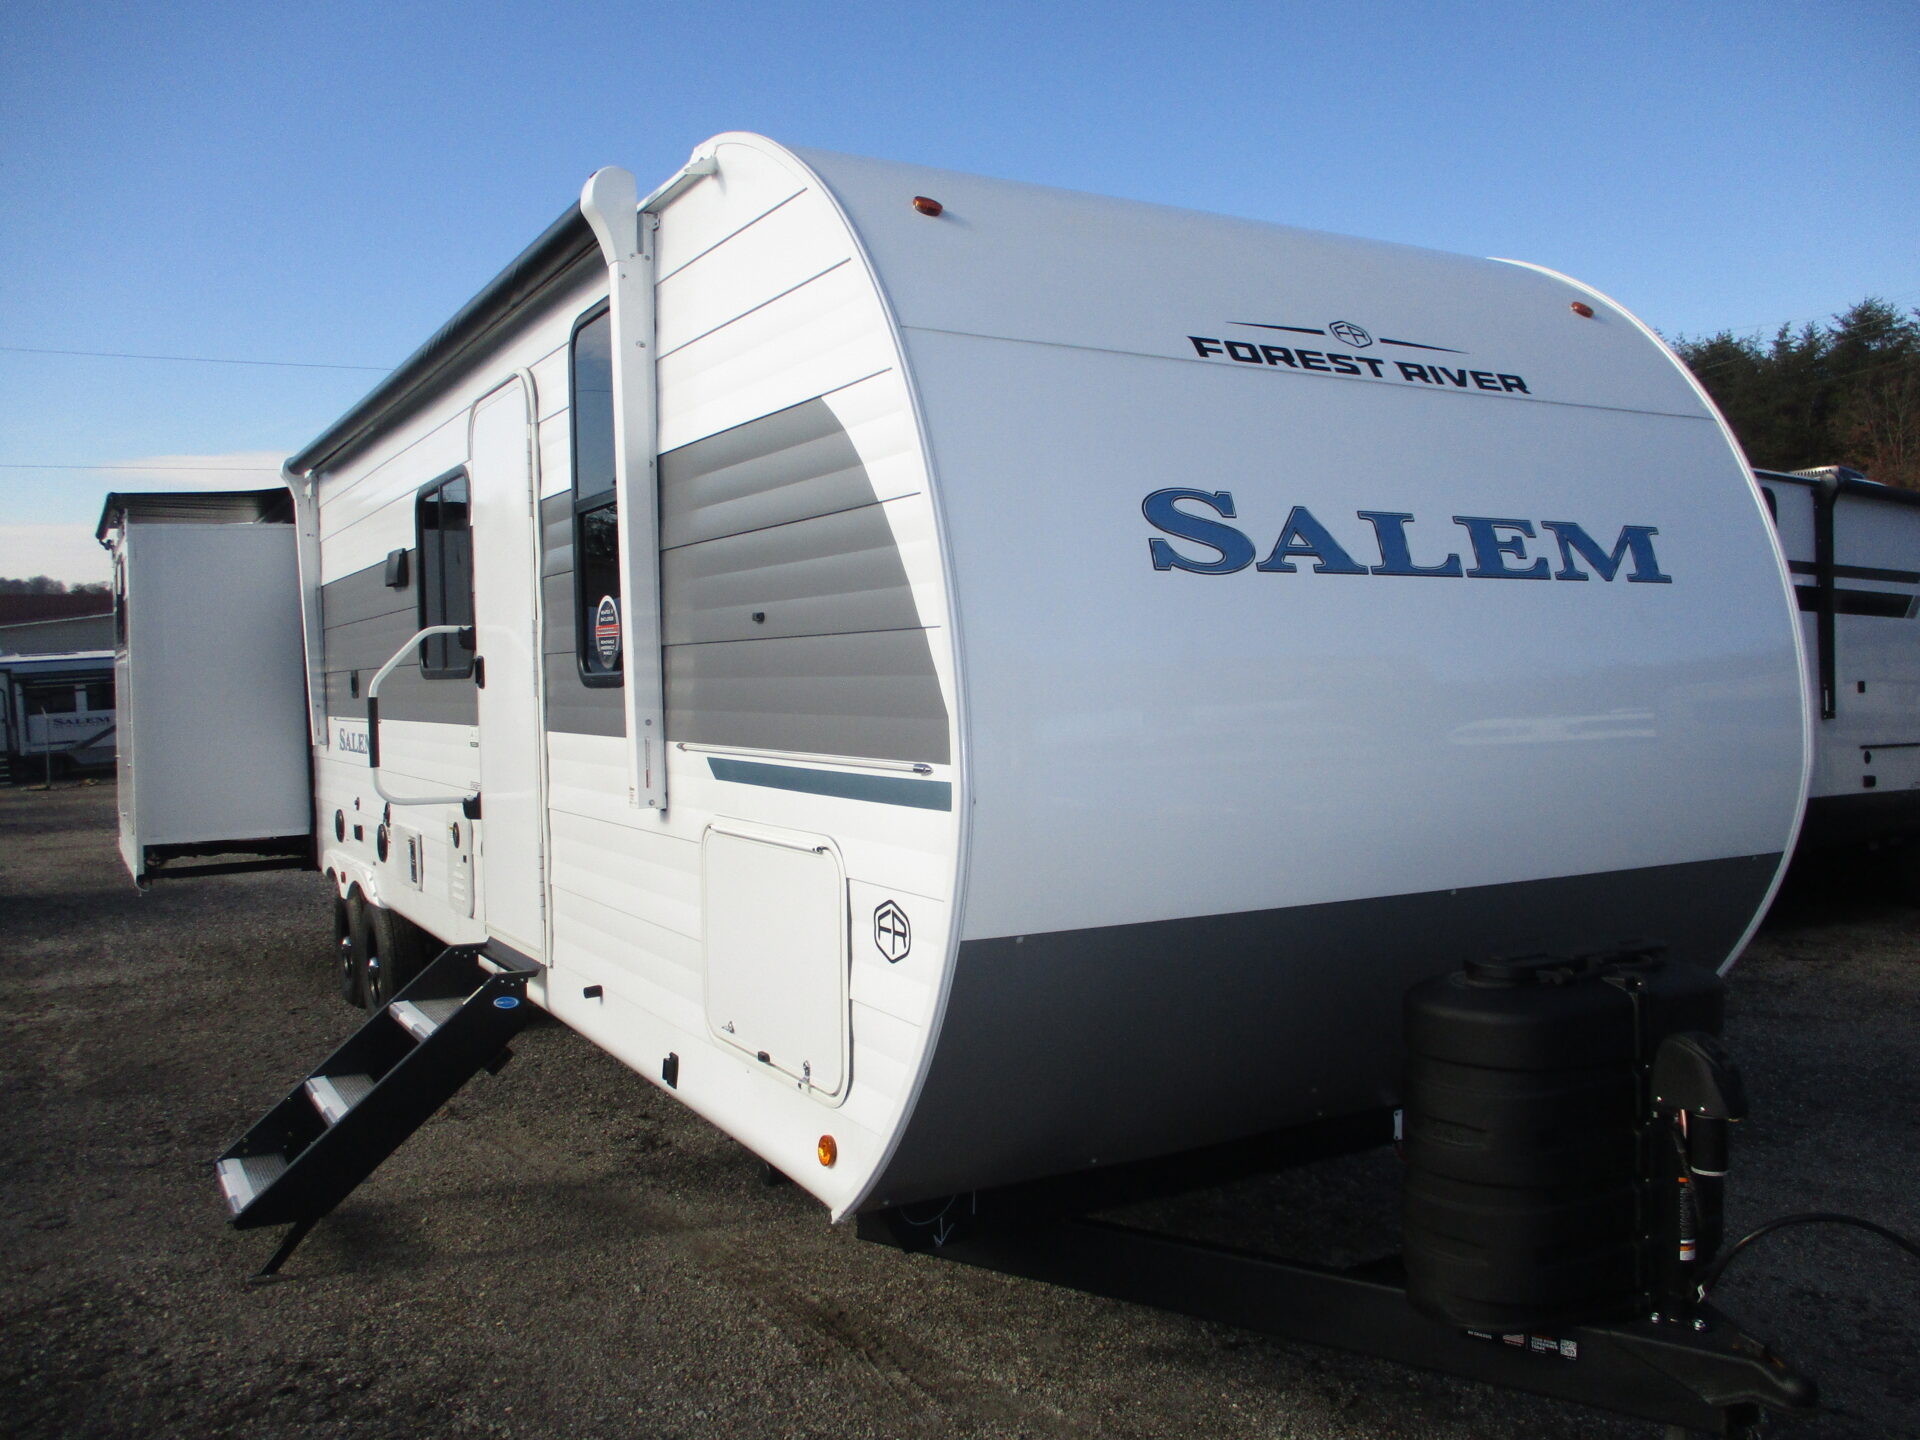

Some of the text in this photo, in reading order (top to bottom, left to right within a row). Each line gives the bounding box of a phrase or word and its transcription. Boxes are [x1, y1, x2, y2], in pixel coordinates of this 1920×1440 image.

[1187, 336, 1532, 394] FOREST RIVER
[1142, 487, 1672, 584] SALEM
[54, 716, 110, 725] SALEM
